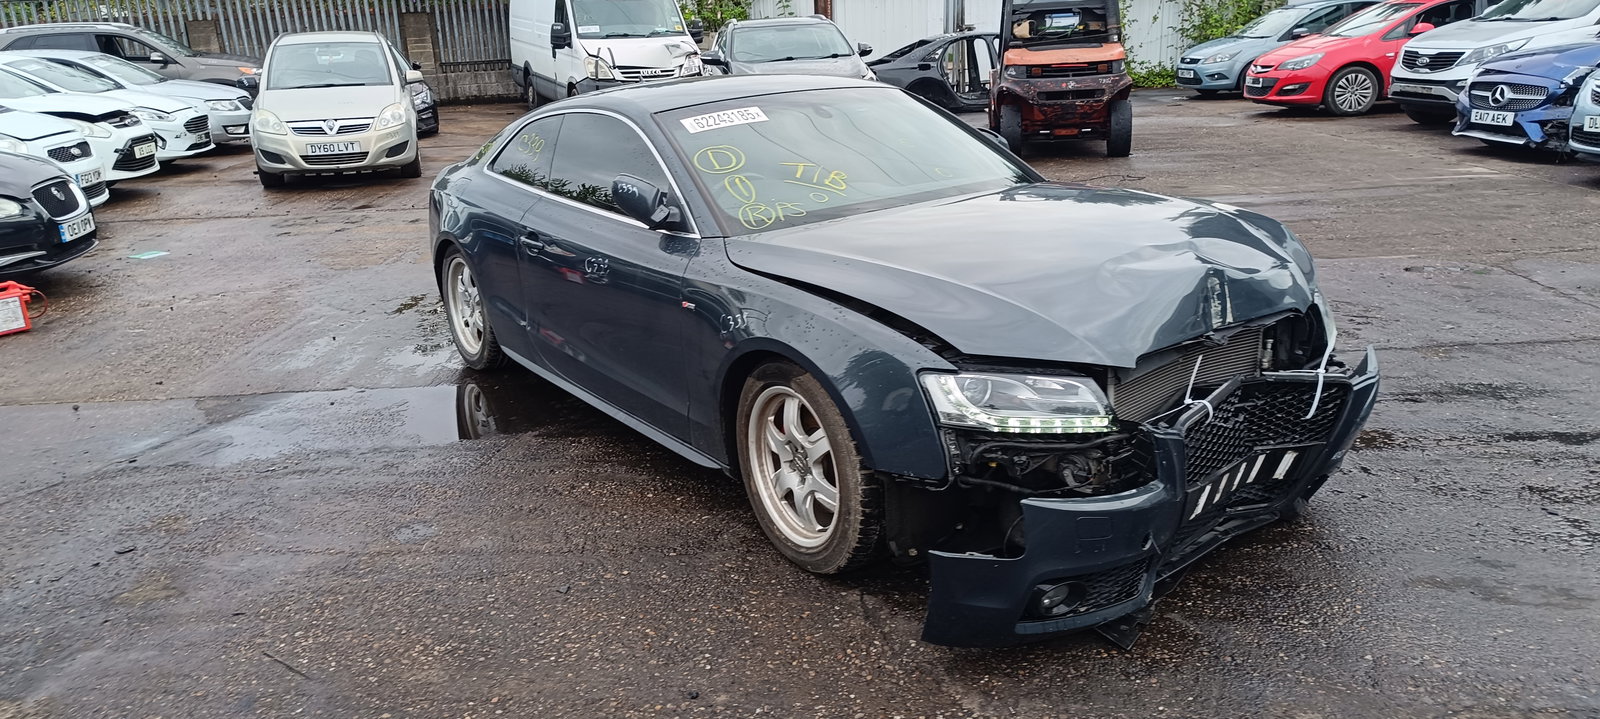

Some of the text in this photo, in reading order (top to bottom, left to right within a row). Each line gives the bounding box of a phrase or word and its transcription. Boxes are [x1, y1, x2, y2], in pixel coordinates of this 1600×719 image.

[693, 109, 756, 129] 62243185
[1474, 111, 1508, 124] EA17 AEK
[310, 142, 356, 154] DY60 LVT
